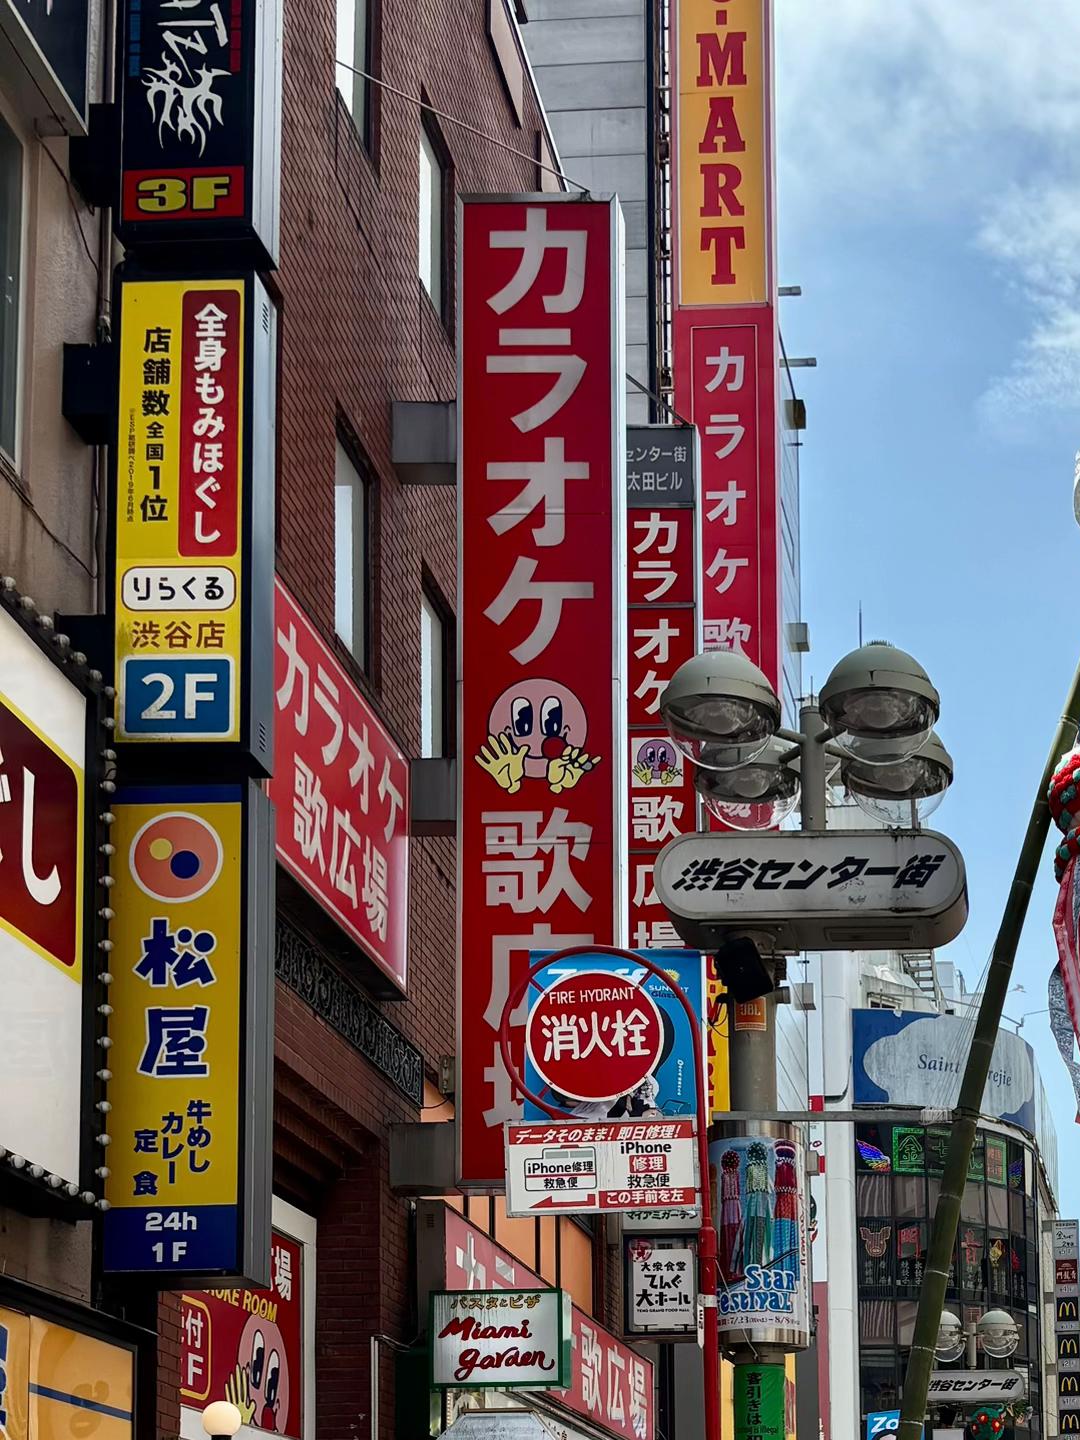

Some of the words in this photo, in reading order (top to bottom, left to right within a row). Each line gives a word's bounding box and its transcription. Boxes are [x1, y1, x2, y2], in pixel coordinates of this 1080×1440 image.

[137, 176, 230, 213] 3F
[140, 326, 172, 523] 店舗数全国1位
[192, 302, 229, 545] 全身もみほぐし
[484, 207, 595, 666] カラオケ
[626, 471, 684, 492] 太田ビル
[132, 576, 225, 602] りらくる
[131, 620, 226, 649] 渋谷店
[140, 672, 218, 720] 2F
[277, 621, 405, 843] カラオケ
[292, 752, 389, 944] 歌広場
[672, 854, 947, 894] 渋谷センター街
[132, 917, 217, 1078] 松屋
[549, 990, 576, 1005] FIRE
[580, 987, 637, 1003] HYDRANT
[739, 1003, 761, 1016] JBL
[540, 1007, 652, 1062] 消火栓
[917, 1053, 961, 1074] Saint
[162, 1110, 185, 1185] カレー
[187, 1099, 212, 1174] 牛めし
[620, 1141, 672, 1155] iPhone
[133, 1128, 160, 1197] 定食
[527, 1161, 594, 1175] iPhone修理
[631, 1155, 665, 1172] 修理
[543, 1177, 579, 1190] 救急便
[627, 1173, 671, 1189] 救急便
[606, 1189, 685, 1205] この手前を左
[145, 1211, 198, 1232] 24h
[151, 1241, 188, 1264] 1F
[640, 1261, 687, 1272] 大衆食堂
[643, 1273, 683, 1289] てんぐ
[242, 1292, 278, 1324] ROOM
[450, 1293, 541, 1311] パスタとピザ
[635, 1288, 692, 1307] 大ホール
[438, 1315, 533, 1342] Miami
[580, 1321, 648, 1440] 歌広場
